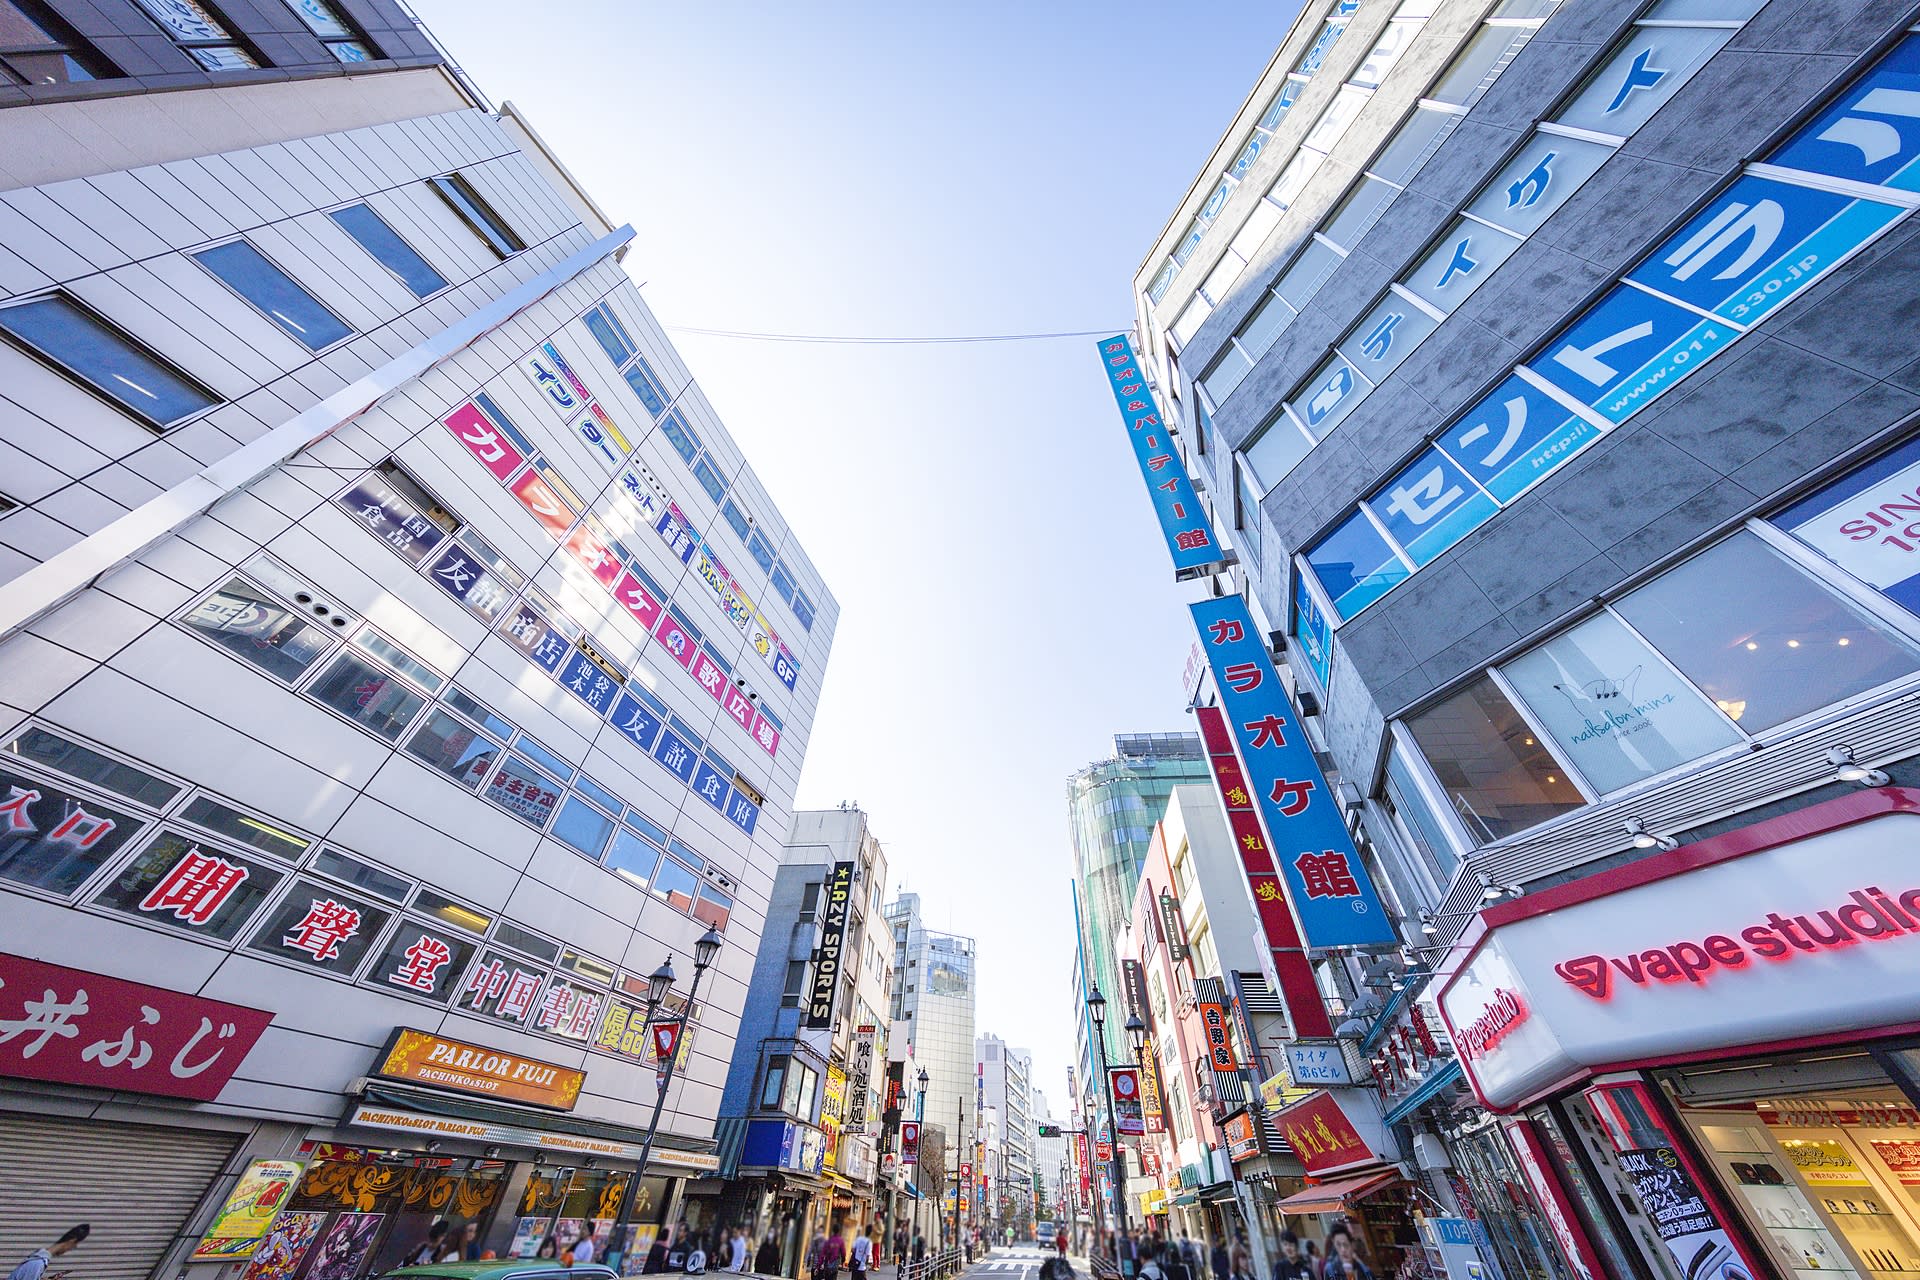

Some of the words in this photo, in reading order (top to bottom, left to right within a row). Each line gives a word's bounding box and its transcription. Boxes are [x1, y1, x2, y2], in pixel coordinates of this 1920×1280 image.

[1839, 486, 1920, 541] SIN
[568, 674, 604, 709] 本店
[577, 660, 611, 696] 池袋
[776, 660, 795, 683] 6F
[1208, 618, 1363, 900] カラオケ館
[827, 881, 849, 927] LAZY
[812, 933, 840, 1019] SPORTS
[0, 976, 236, 1079] 井ふじ
[1206, 1008, 1231, 1065] 吉野家
[427, 1043, 511, 1077] PARLOR
[512, 1062, 558, 1086] FUJI
[1295, 1050, 1328, 1062] カイダ
[417, 1067, 500, 1091] PACHINKO&SLOT
[1148, 1116, 1163, 1131] B1
